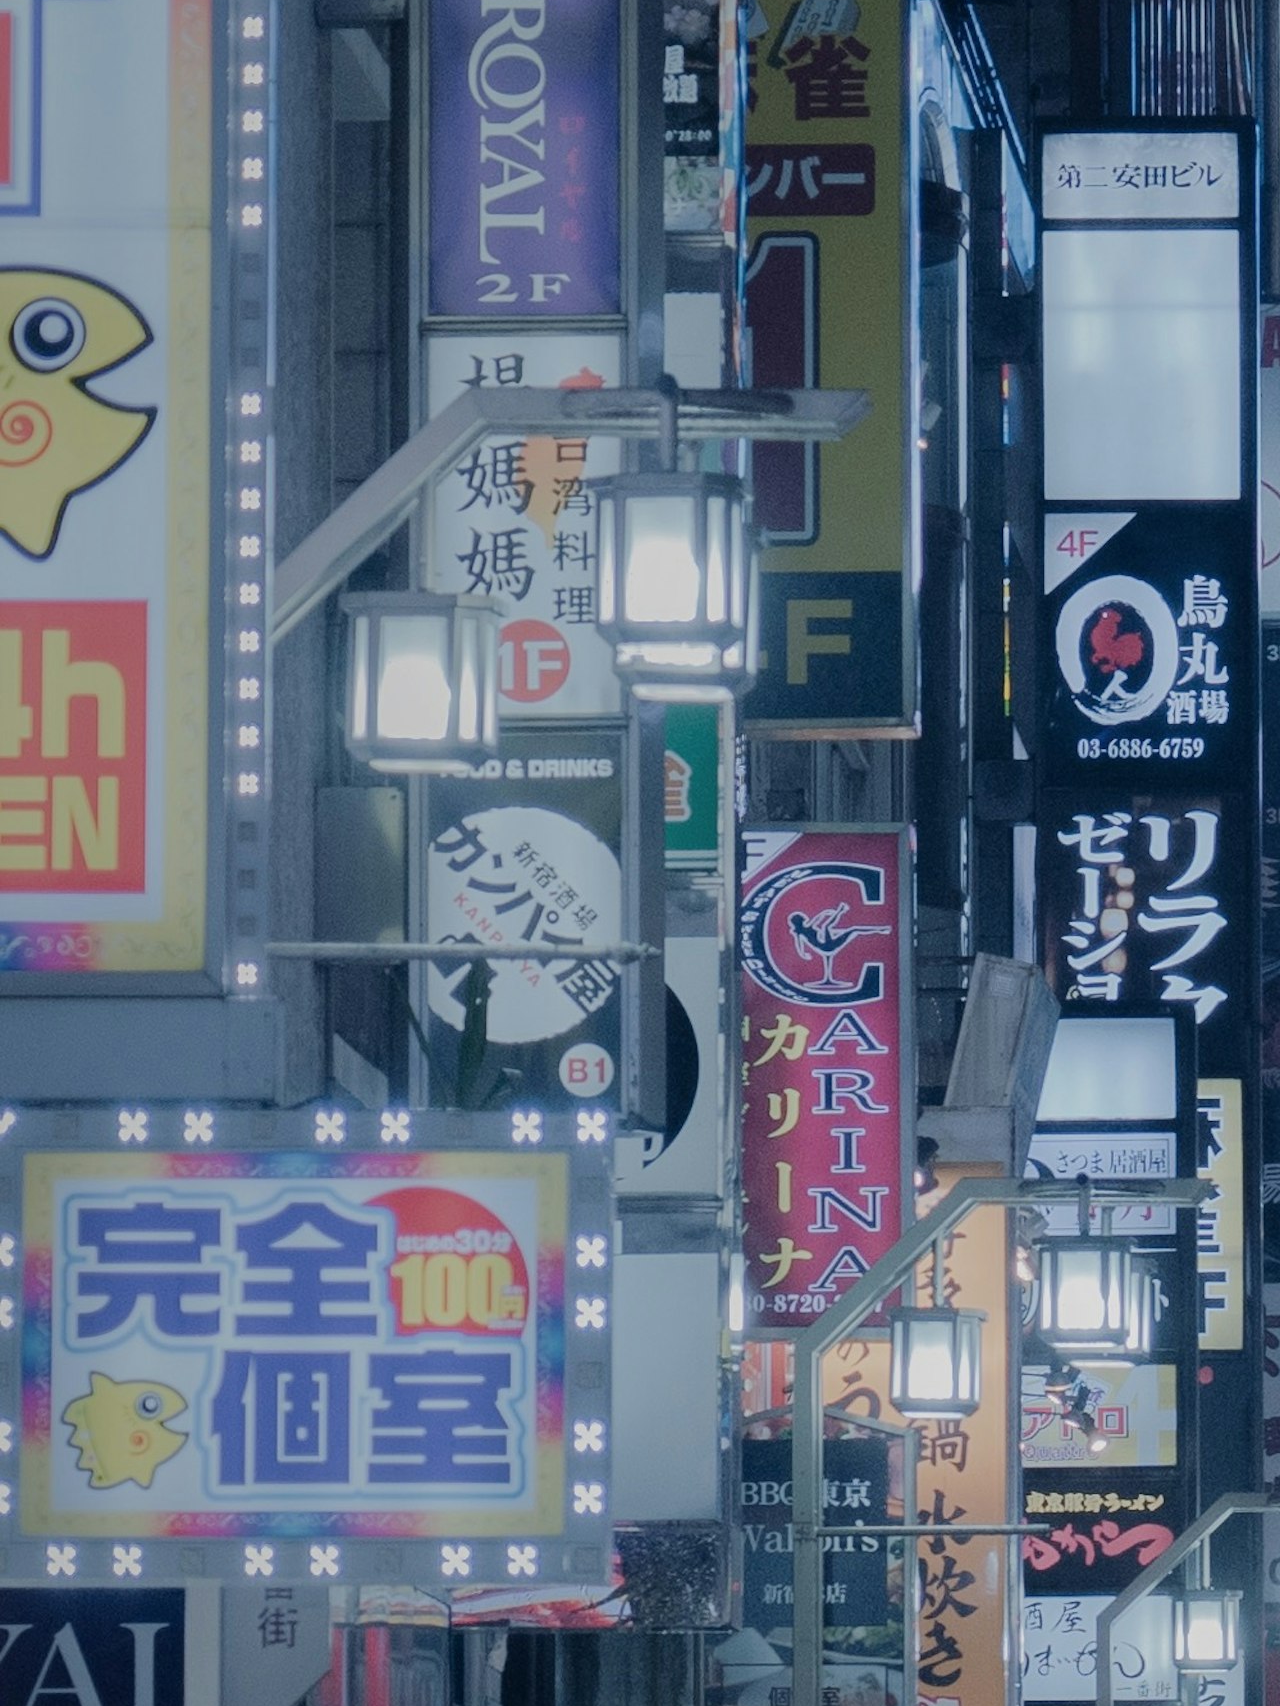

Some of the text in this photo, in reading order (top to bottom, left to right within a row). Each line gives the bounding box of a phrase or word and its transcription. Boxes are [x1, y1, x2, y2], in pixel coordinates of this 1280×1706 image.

[745, 35, 871, 122] 雀
[1056, 163, 1224, 190] 第二安田ビル
[474, 272, 572, 304] 2F
[1056, 530, 1098, 557] 4F
[1166, 689, 1230, 726] 酒場
[1076, 739, 1206, 759] 03-6886-6759
[527, 758, 614, 781] DRINKS
[511, 837, 604, 933] 新宿酒場
[566, 1057, 607, 1086] B1
[741, 860, 888, 1293] CARINA
[754, 1012, 814, 1291] カリーナ
[1109, 1148, 1169, 1174] 居酒屋
[77, 1201, 379, 1340] 完全
[210, 1349, 513, 1485] 個室
